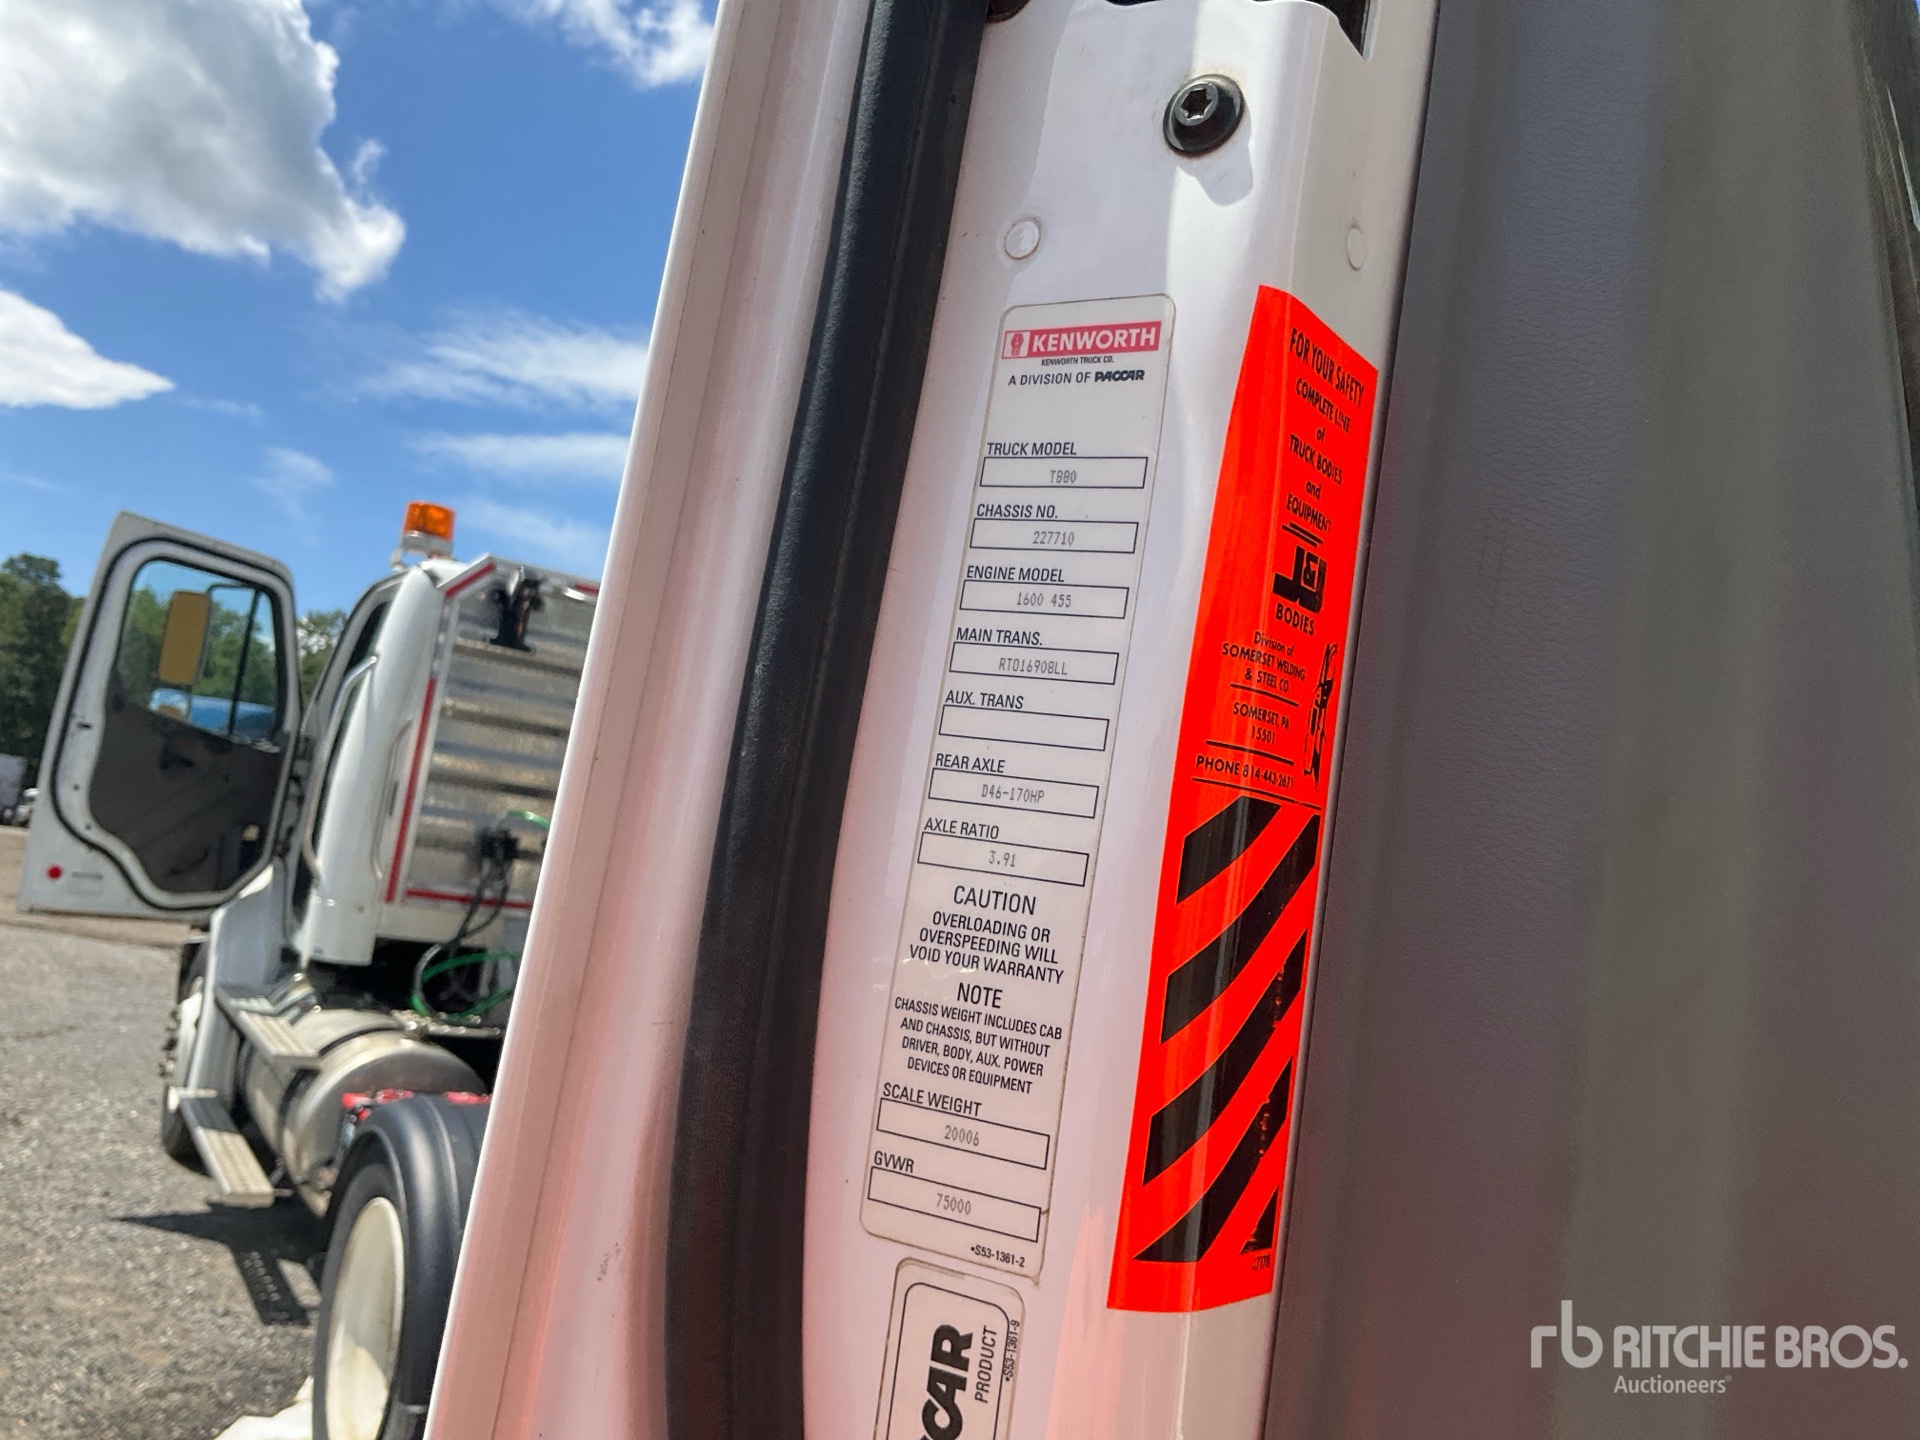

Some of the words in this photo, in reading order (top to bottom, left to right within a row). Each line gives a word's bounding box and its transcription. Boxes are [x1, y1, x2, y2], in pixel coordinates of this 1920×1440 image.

[1032, 327, 1155, 352] KENWORTH
[1041, 358, 1078, 366] KENWORTH
[1290, 328, 1311, 364] FOR
[1312, 345, 1335, 384] YOUR
[1336, 365, 1364, 407] SAFETY
[1008, 376, 1017, 385] A
[1020, 373, 1071, 385] DIVISION
[1076, 372, 1091, 382] OF
[1094, 370, 1145, 382] PACCAR
[1296, 378, 1334, 421] COMPLETE
[1316, 427, 1325, 443] of
[987, 443, 1029, 455] TRUCK
[1031, 442, 1076, 455] MODEL
[1290, 433, 1314, 467] TRUCK
[1317, 453, 1342, 485] BODIES
[1050, 470, 1076, 483] T880
[1306, 480, 1321, 499] and
[976, 504, 1033, 518] CHASSIS
[1036, 505, 1058, 519] NO.
[1287, 493, 1331, 533] EQUIPMENT
[1032, 531, 1074, 545] 227710
[967, 566, 1016, 580] ENGINE
[1018, 568, 1064, 582] MODEL
[1017, 592, 1044, 606] 1600
[1051, 594, 1072, 607] 455
[1276, 603, 1315, 636] BODIES
[956, 628, 992, 642] MAIN
[996, 630, 1042, 646] TRANS.
[1254, 631, 1285, 652] Division
[1287, 644, 1294, 656] of
[1222, 642, 1275, 667] SOMERSET
[1277, 657, 1305, 681] WELDING
[1245, 668, 1252, 680] &
[1257, 670, 1277, 688] STEEL
[945, 690, 975, 705] AUX.
[980, 693, 1024, 709] TRANS
[1281, 716, 1289, 730] PA
[1251, 726, 1275, 744] 15501
[935, 754, 969, 770] REAR
[972, 757, 1005, 773] AXLE
[1196, 755, 1240, 776] PHONE
[981, 784, 1044, 803] D46-170HP
[924, 818, 957, 833] AXLE
[960, 822, 999, 839] RATIO
[989, 851, 1015, 867] 3.91
[953, 885, 1036, 915] CAUTION
[932, 911, 1028, 939] OVERLOADING
[1031, 927, 1050, 943] OR
[920, 928, 1021, 957] OVERSPEEDING
[1025, 944, 1058, 964] WILL
[910, 944, 941, 962] VOID
[945, 951, 980, 969] YOUR
[984, 957, 1064, 984] WARRANTY
[957, 982, 1003, 1009] NOTE
[895, 997, 939, 1016] CHASSIS
[941, 1005, 983, 1025] WEIGHT
[984, 1014, 1037, 1035] INCLUDES
[1039, 1025, 1062, 1040] CAB
[901, 1017, 923, 1032] AND
[926, 1022, 972, 1044] CHASSIS,
[975, 1031, 997, 1046] BUT
[1000, 1036, 1050, 1057] WITHOUT
[902, 1036, 940, 1057] DRIVER,
[943, 1044, 973, 1064] BODY,
[976, 1051, 1001, 1068] AUX.
[1004, 1057, 1044, 1076] POWER
[907, 1057, 950, 1076] DEVICES
[952, 1066, 967, 1081] OR
[969, 1069, 1032, 1094] EQUIPMENT
[883, 1083, 925, 1104] SCALE
[928, 1091, 982, 1117] WEIGHT
[944, 1125, 979, 1147] 20006
[874, 1151, 914, 1173] GVWR
[936, 1193, 971, 1215] 75000
[975, 1325, 997, 1403] PRODUCT
